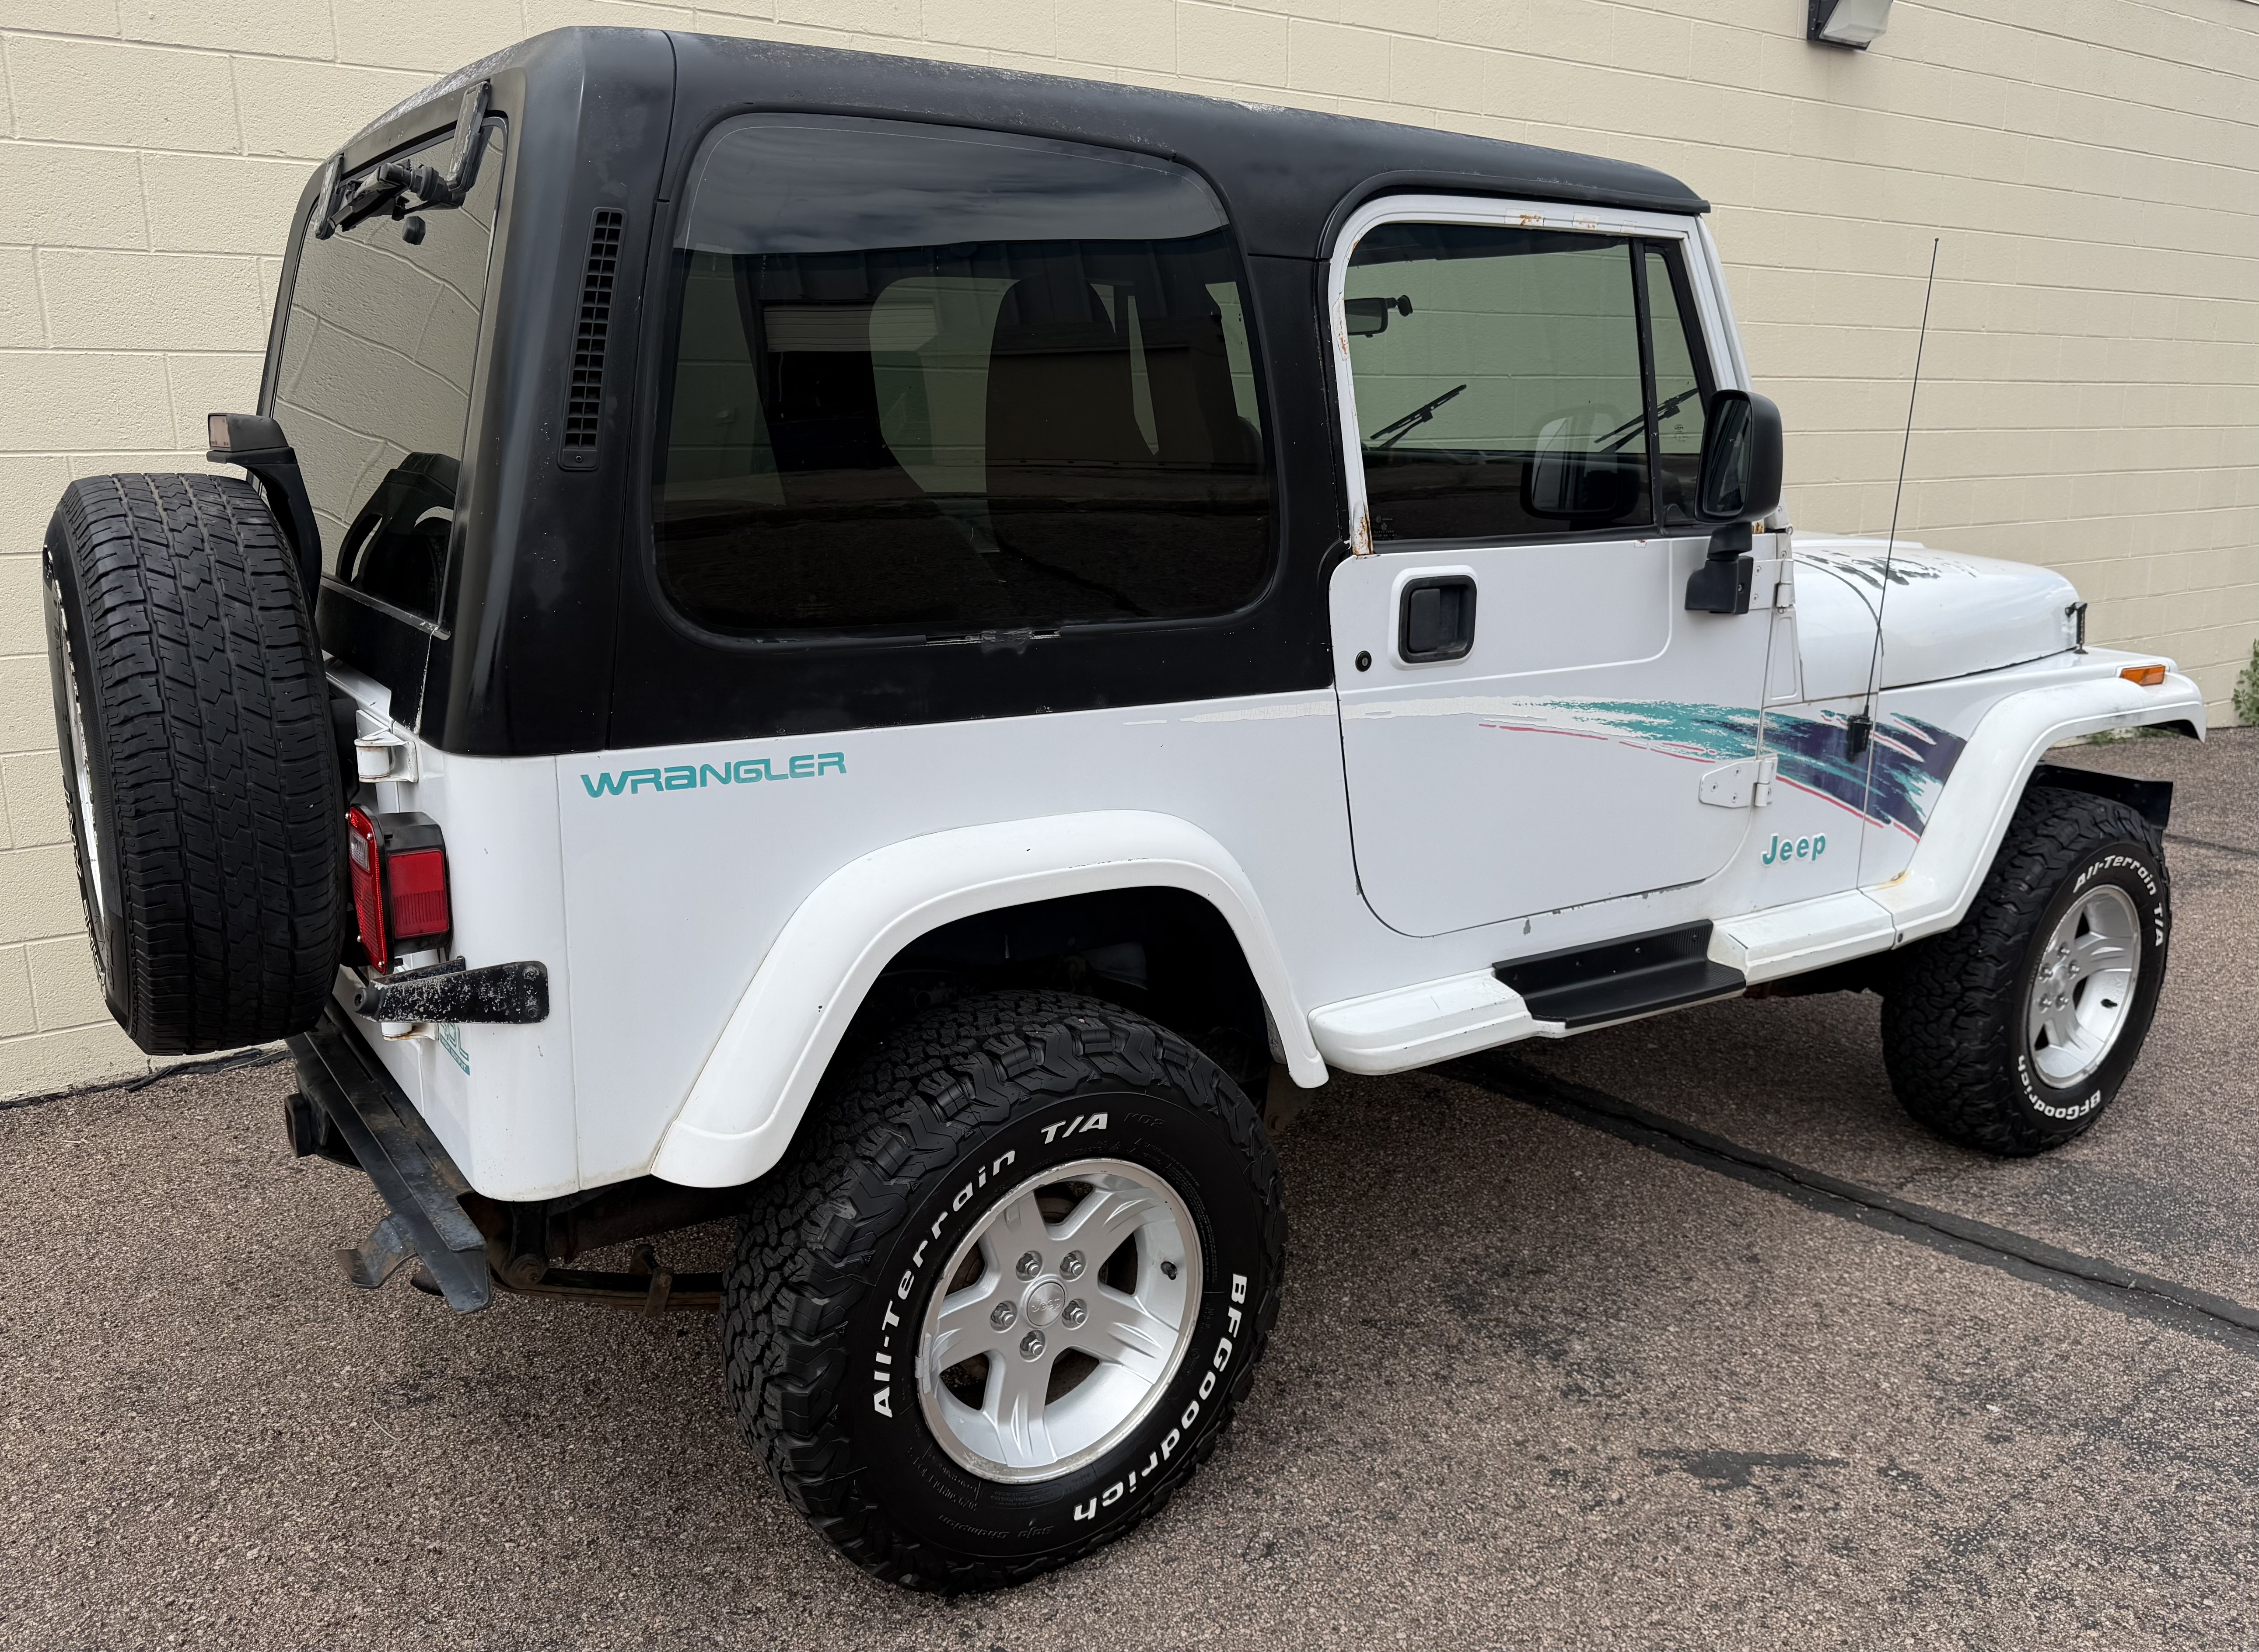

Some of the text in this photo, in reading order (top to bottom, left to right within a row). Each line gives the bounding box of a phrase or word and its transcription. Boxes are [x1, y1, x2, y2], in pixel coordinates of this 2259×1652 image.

[580, 752, 846, 798] WRANGLER
[1762, 834, 1826, 866] Jeep
[2073, 855, 2164, 946] All-Terrain T/A
[2018, 1055, 2101, 1120] BFGoodrich
[874, 1150, 1015, 1417] All-Terrain
[1040, 1112, 1109, 1145] T/A
[1031, 1298, 1061, 1313] Jeep
[1074, 1273, 1247, 1521] BFGoodrich
